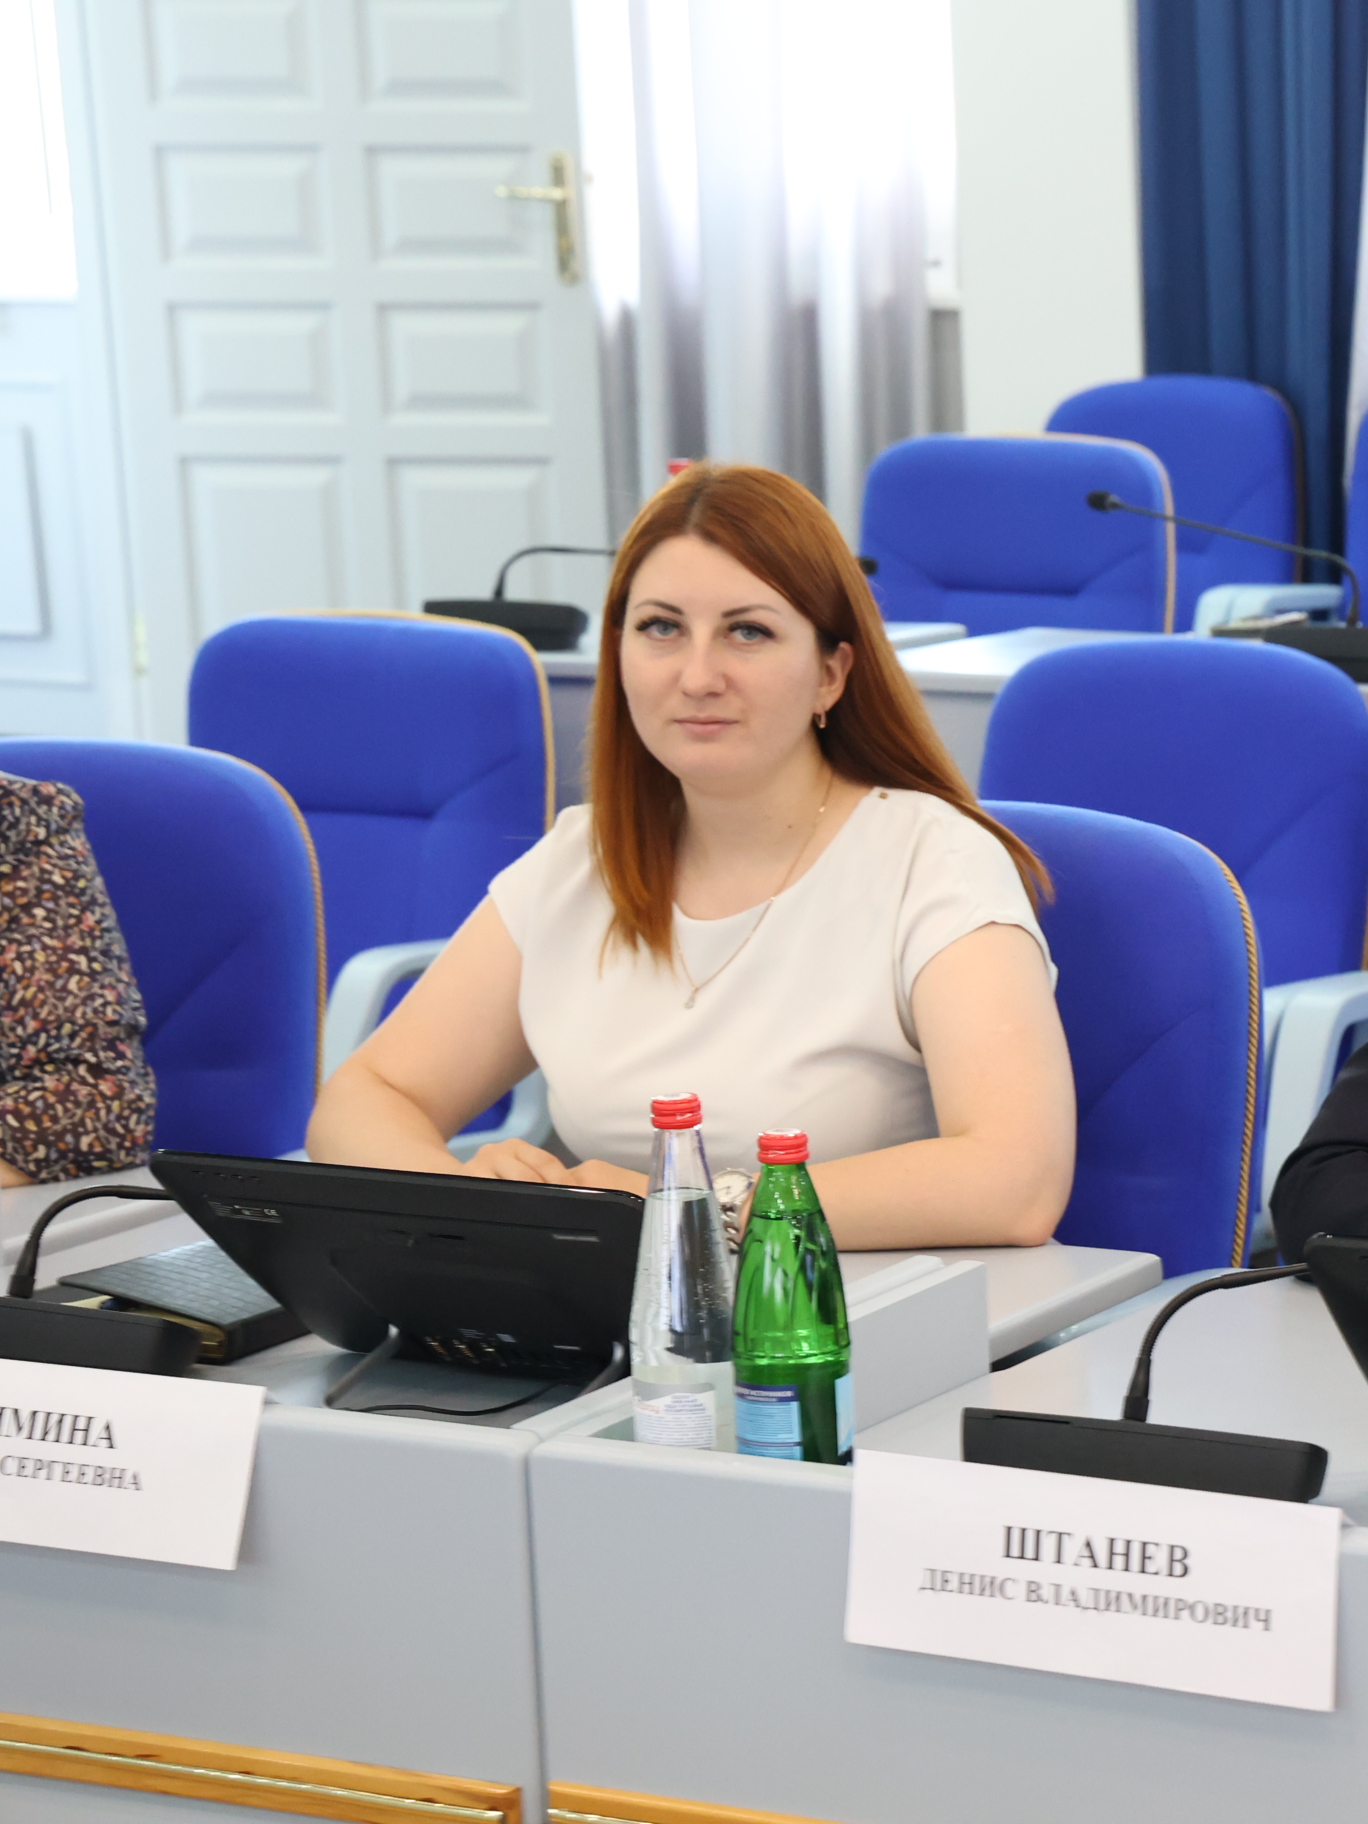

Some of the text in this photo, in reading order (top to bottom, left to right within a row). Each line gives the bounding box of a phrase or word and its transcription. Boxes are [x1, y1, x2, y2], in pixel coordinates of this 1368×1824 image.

[0, 1405, 116, 1449] МИНА
[0, 1455, 142, 1491] СЕРГЕЕВНА
[1003, 1525, 1190, 1578] ШТАНЕВ
[919, 1568, 1273, 1632] ДЕНИС ВЛАДИМИРОВИЧ
